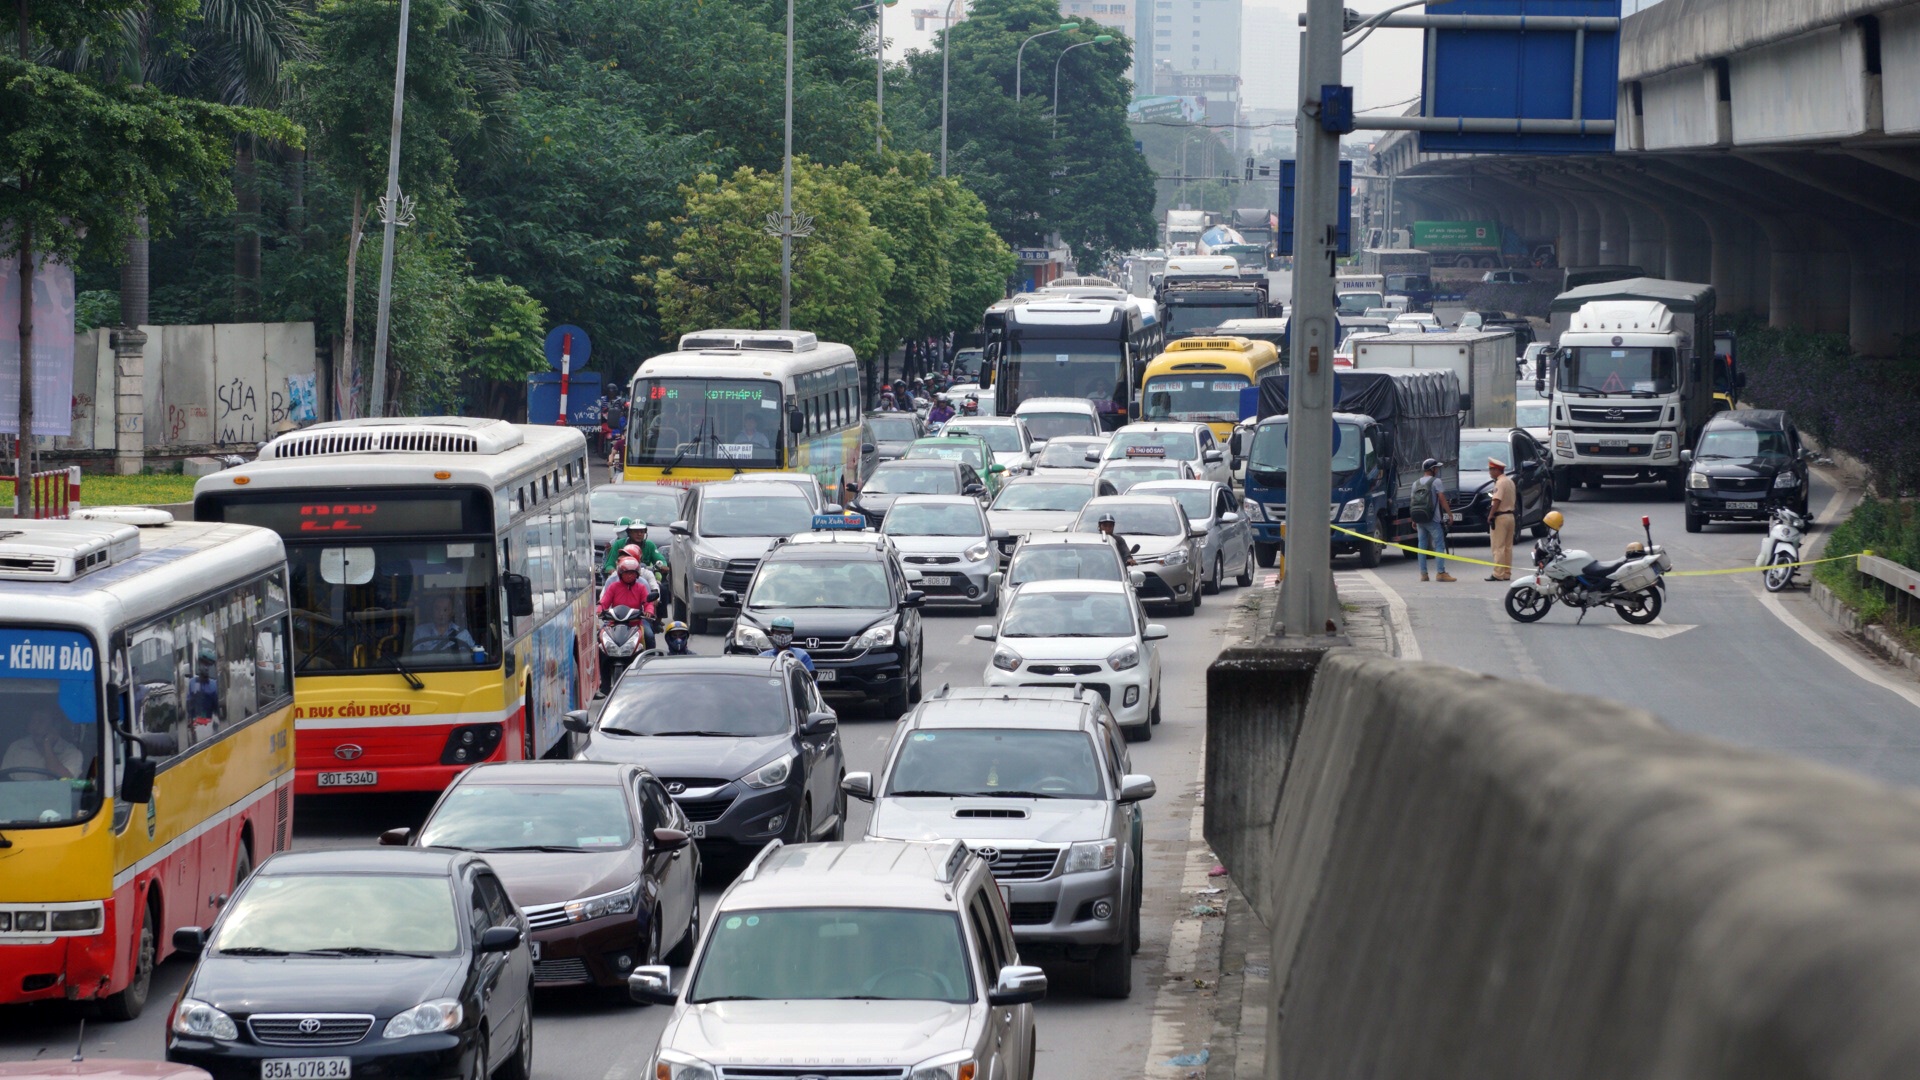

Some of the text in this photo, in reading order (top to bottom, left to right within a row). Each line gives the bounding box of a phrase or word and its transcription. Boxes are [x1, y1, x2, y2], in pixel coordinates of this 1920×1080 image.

[726, 388, 752, 400] PHÁP
[10, 639, 93, 671] KÊNH ĐÀO
[309, 706, 335, 718] BUS
[322, 772, 375, 785] 30T-5340
[265, 1060, 347, 1079] 35A-078.34
